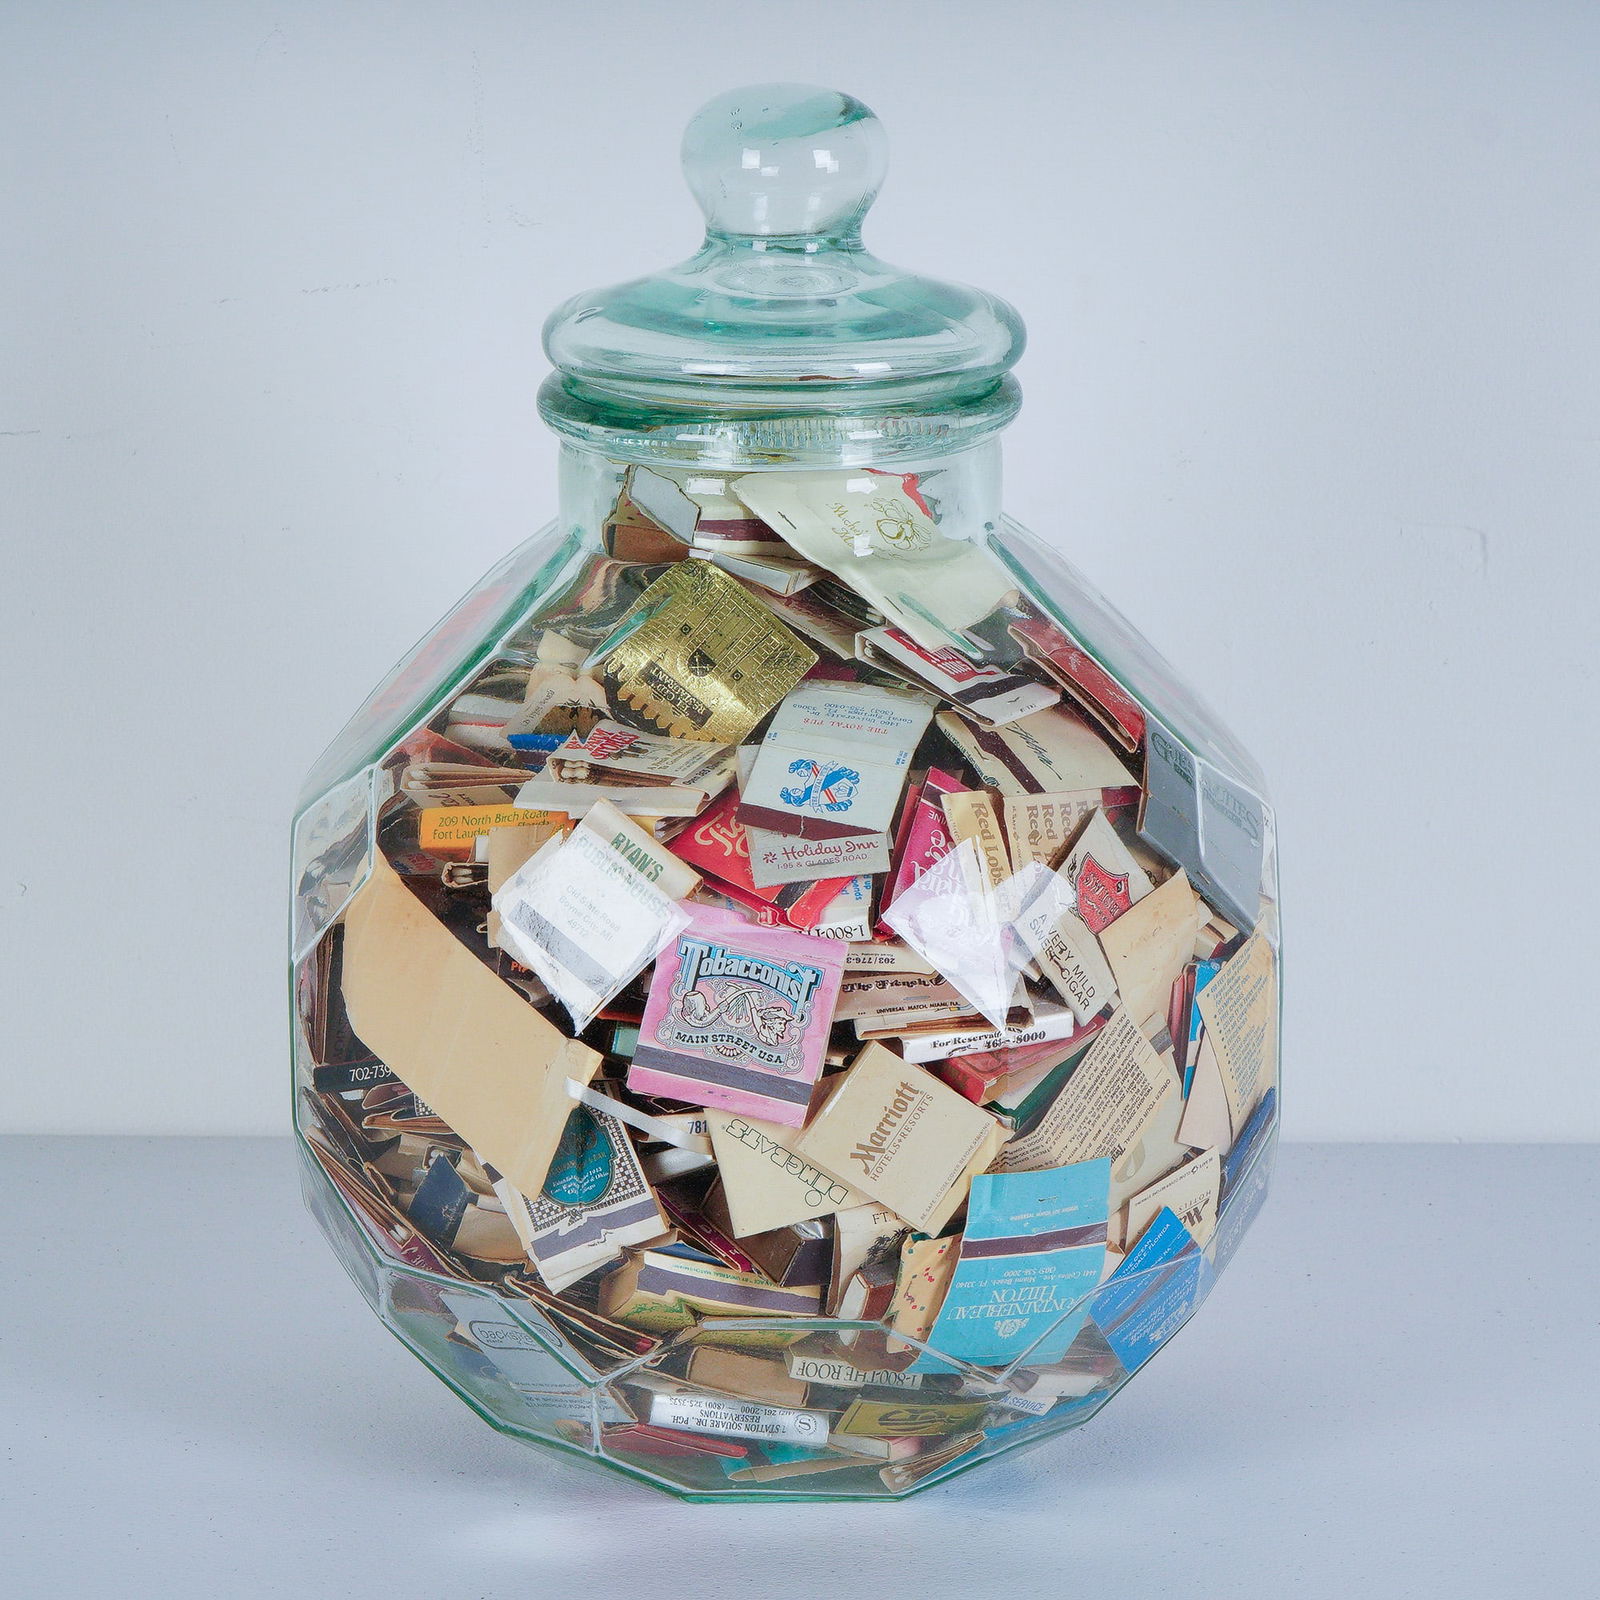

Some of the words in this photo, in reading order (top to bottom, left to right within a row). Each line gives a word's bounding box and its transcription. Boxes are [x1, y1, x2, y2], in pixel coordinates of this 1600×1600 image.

[648, 665, 707, 714] RESTAURANT
[803, 718, 824, 726] PUB
[826, 713, 877, 724] University
[830, 721, 862, 730] ROYAL
[867, 726, 888, 735] THE
[438, 816, 459, 828] 209
[462, 815, 492, 826] North
[494, 811, 520, 823] Birch
[971, 802, 995, 840] Red
[1041, 803, 1057, 840] Red
[433, 829, 452, 840] Fort
[610, 832, 664, 883] RYAN'S
[782, 842, 843, 862] Holiday
[844, 840, 878, 852] Inn
[805, 856, 841, 867] GLADES
[842, 853, 868, 862] ROAD
[1038, 913, 1047, 925] A
[1047, 925, 1074, 961] VERY
[1072, 964, 1095, 998] MILD
[680, 940, 820, 1012] Tobacconist
[842, 982, 873, 993] The
[1061, 968, 1090, 1011] CIGAR
[876, 1006, 905, 1014] UNIVERSAL
[675, 1031, 709, 1044] MAIN
[711, 1034, 758, 1054] STREET
[758, 1051, 784, 1064] USA
[932, 1039, 950, 1049] For
[1120, 1035, 1141, 1067] CALIFORNIA
[350, 1064, 391, 1081] 702-739
[1101, 1065, 1120, 1095] RESIDENTS
[1120, 1061, 1136, 1085] TWILIGHT
[1125, 1068, 1142, 1093] TWILIGHT
[1104, 1075, 1120, 1100] INDICATE
[1136, 1085, 1152, 1110] TWILIGHT
[1155, 1078, 1169, 1100] ORDER
[1126, 1095, 1139, 1115] CHOICE
[1143, 1099, 1155, 1117] YOUR
[687, 1119, 708, 1134] 781
[850, 1080, 921, 1176] Marriott
[1124, 1117, 1143, 1145] OFFICIAL
[870, 1143, 901, 1182] HOTELS
[900, 1094, 934, 1140] RESORTS
[924, 1199, 936, 1212] SAFE
[946, 1164, 960, 1181] COVER
[958, 1144, 974, 1164] BEFORE
[872, 1211, 889, 1225] FT.
[1149, 1223, 1171, 1252] FLORIDA
[1134, 1239, 1153, 1262] OCEAN
[1061, 1271, 1081, 1280] Collins
[991, 1285, 1058, 1303] HILTON
[797, 1360, 843, 1380] ROOF
[704, 1401, 726, 1409] (800)
[740, 1405, 778, 1416] 261-2000
[1010, 1396, 1046, 1412] SERVICE
[671, 1415, 690, 1424] PGH.
[699, 1410, 761, 1423] RESERVATIONS
[709, 1418, 743, 1432] SQUARE
[743, 1421, 781, 1434] STATION
